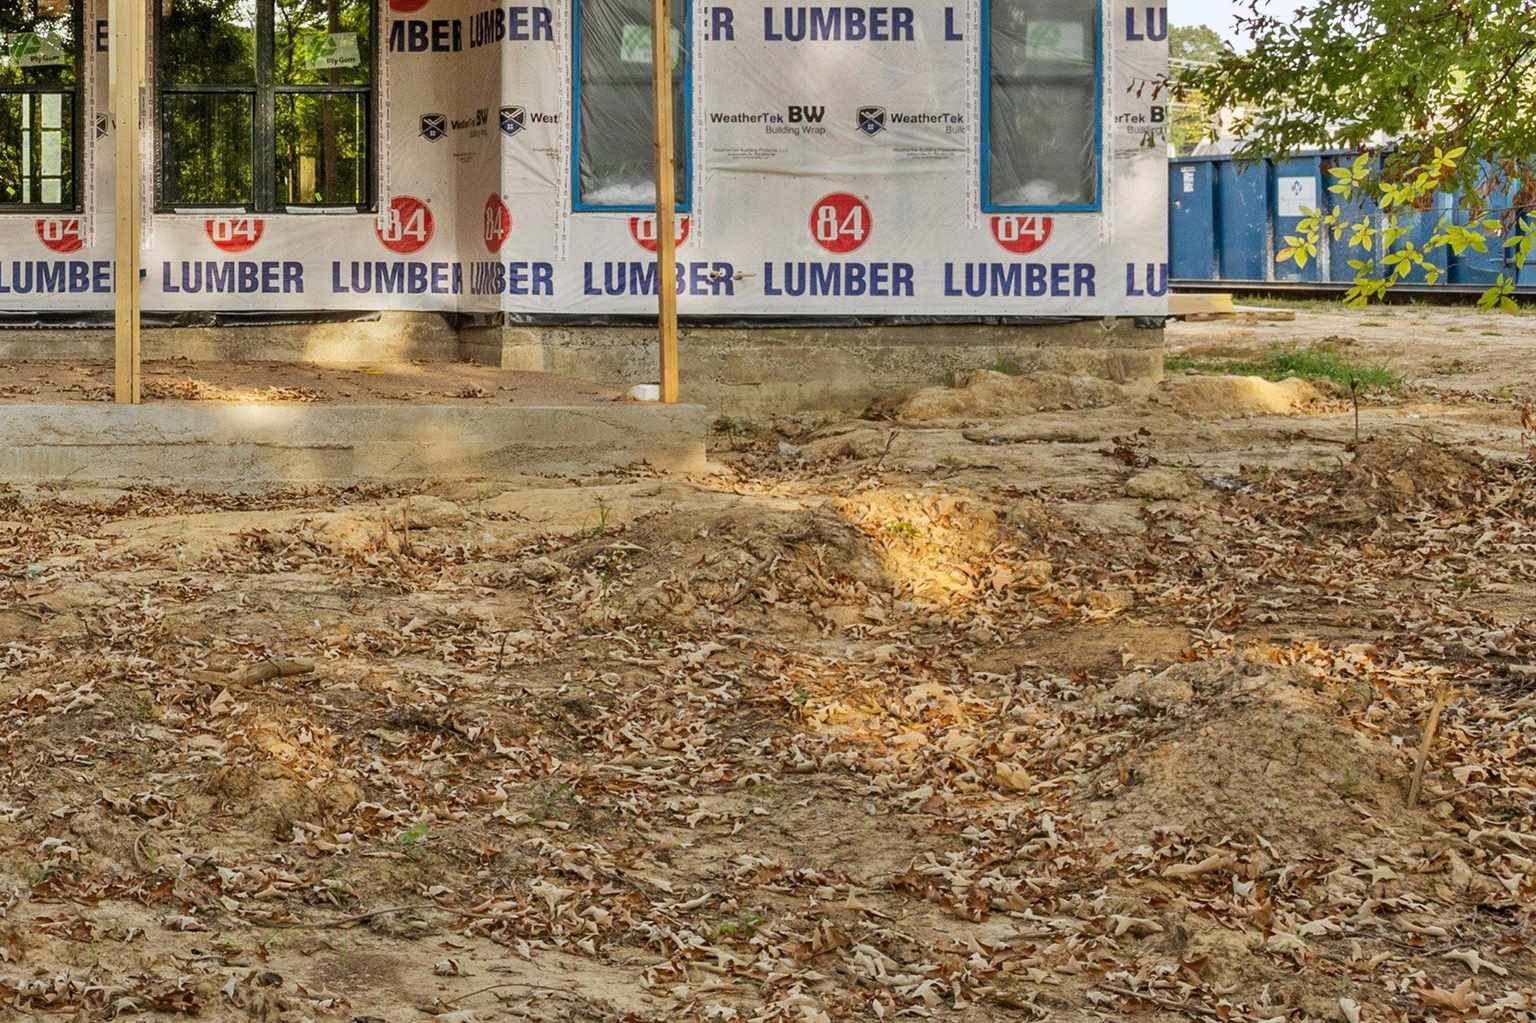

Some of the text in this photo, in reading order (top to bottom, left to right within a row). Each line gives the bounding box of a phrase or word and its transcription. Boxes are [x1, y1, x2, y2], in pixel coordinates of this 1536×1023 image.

[470, 7, 555, 49] LUMBER
[763, 6, 915, 42] LUMBER
[709, 105, 826, 124] WeatherTek BW
[765, 125, 827, 137] Building Wrap
[890, 112, 965, 125] WeatherTek
[816, 205, 865, 241] 84
[162, 260, 305, 294] LUMBER
[469, 260, 555, 296] LUMBER
[763, 261, 915, 297] LUMBER
[943, 262, 1097, 297] LUMBER
